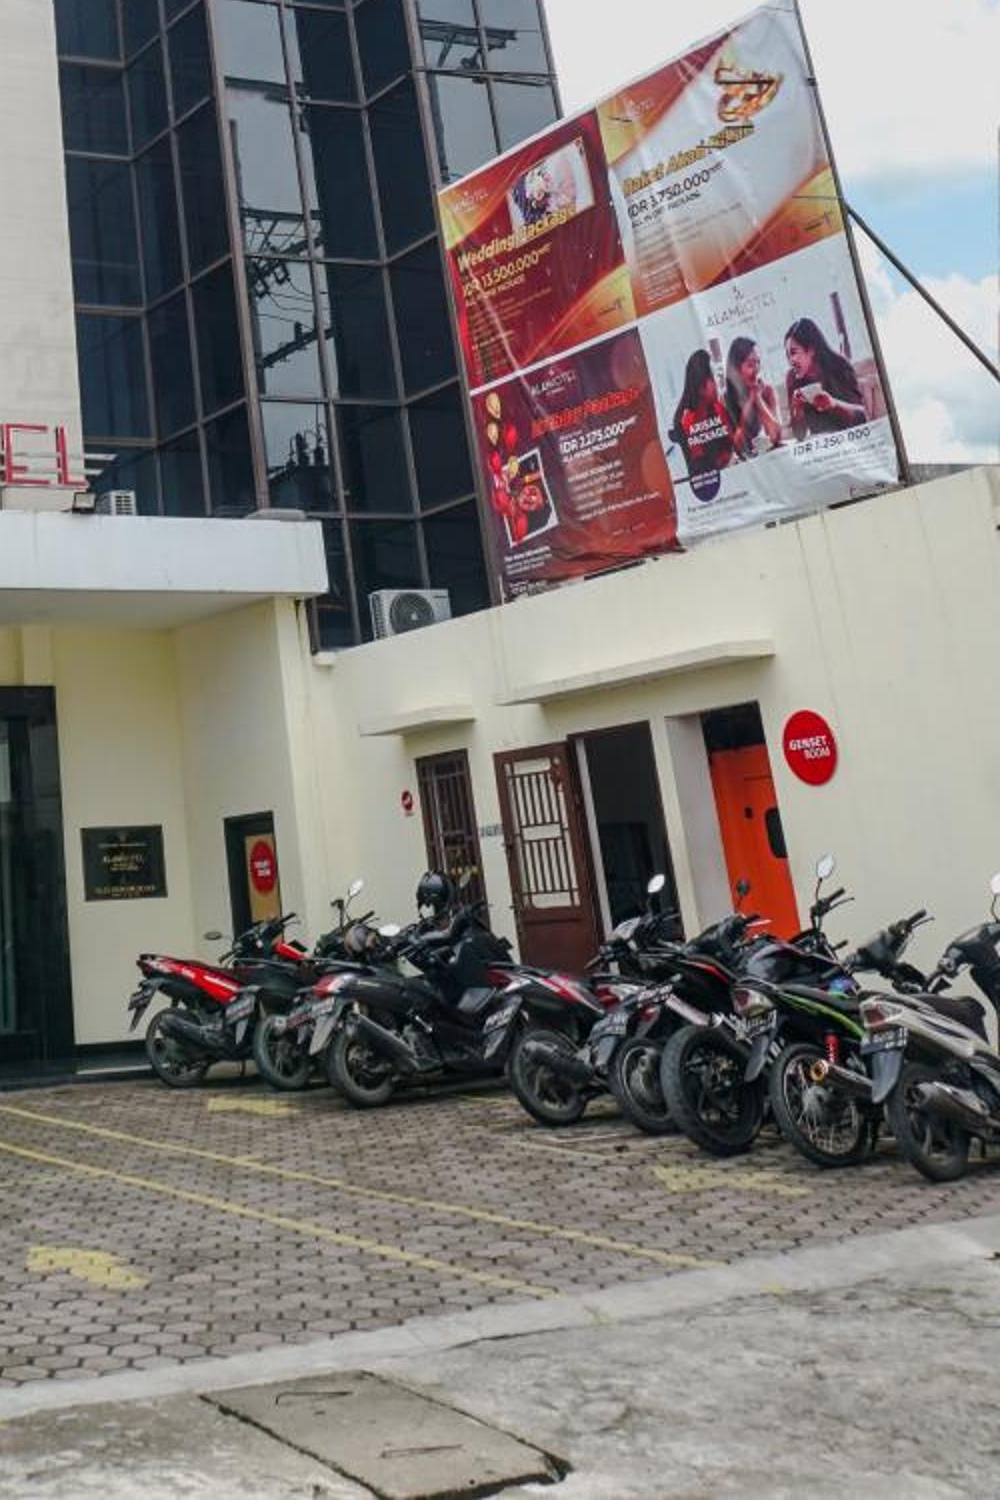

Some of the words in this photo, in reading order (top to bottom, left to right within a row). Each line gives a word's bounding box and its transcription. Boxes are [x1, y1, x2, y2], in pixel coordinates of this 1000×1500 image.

[457, 233, 517, 272] Wedding
[688, 415, 722, 435] ARISAN
[687, 427, 729, 447] PACKAGE
[789, 735, 827, 751] GENSET
[804, 746, 831, 760] ROOM
